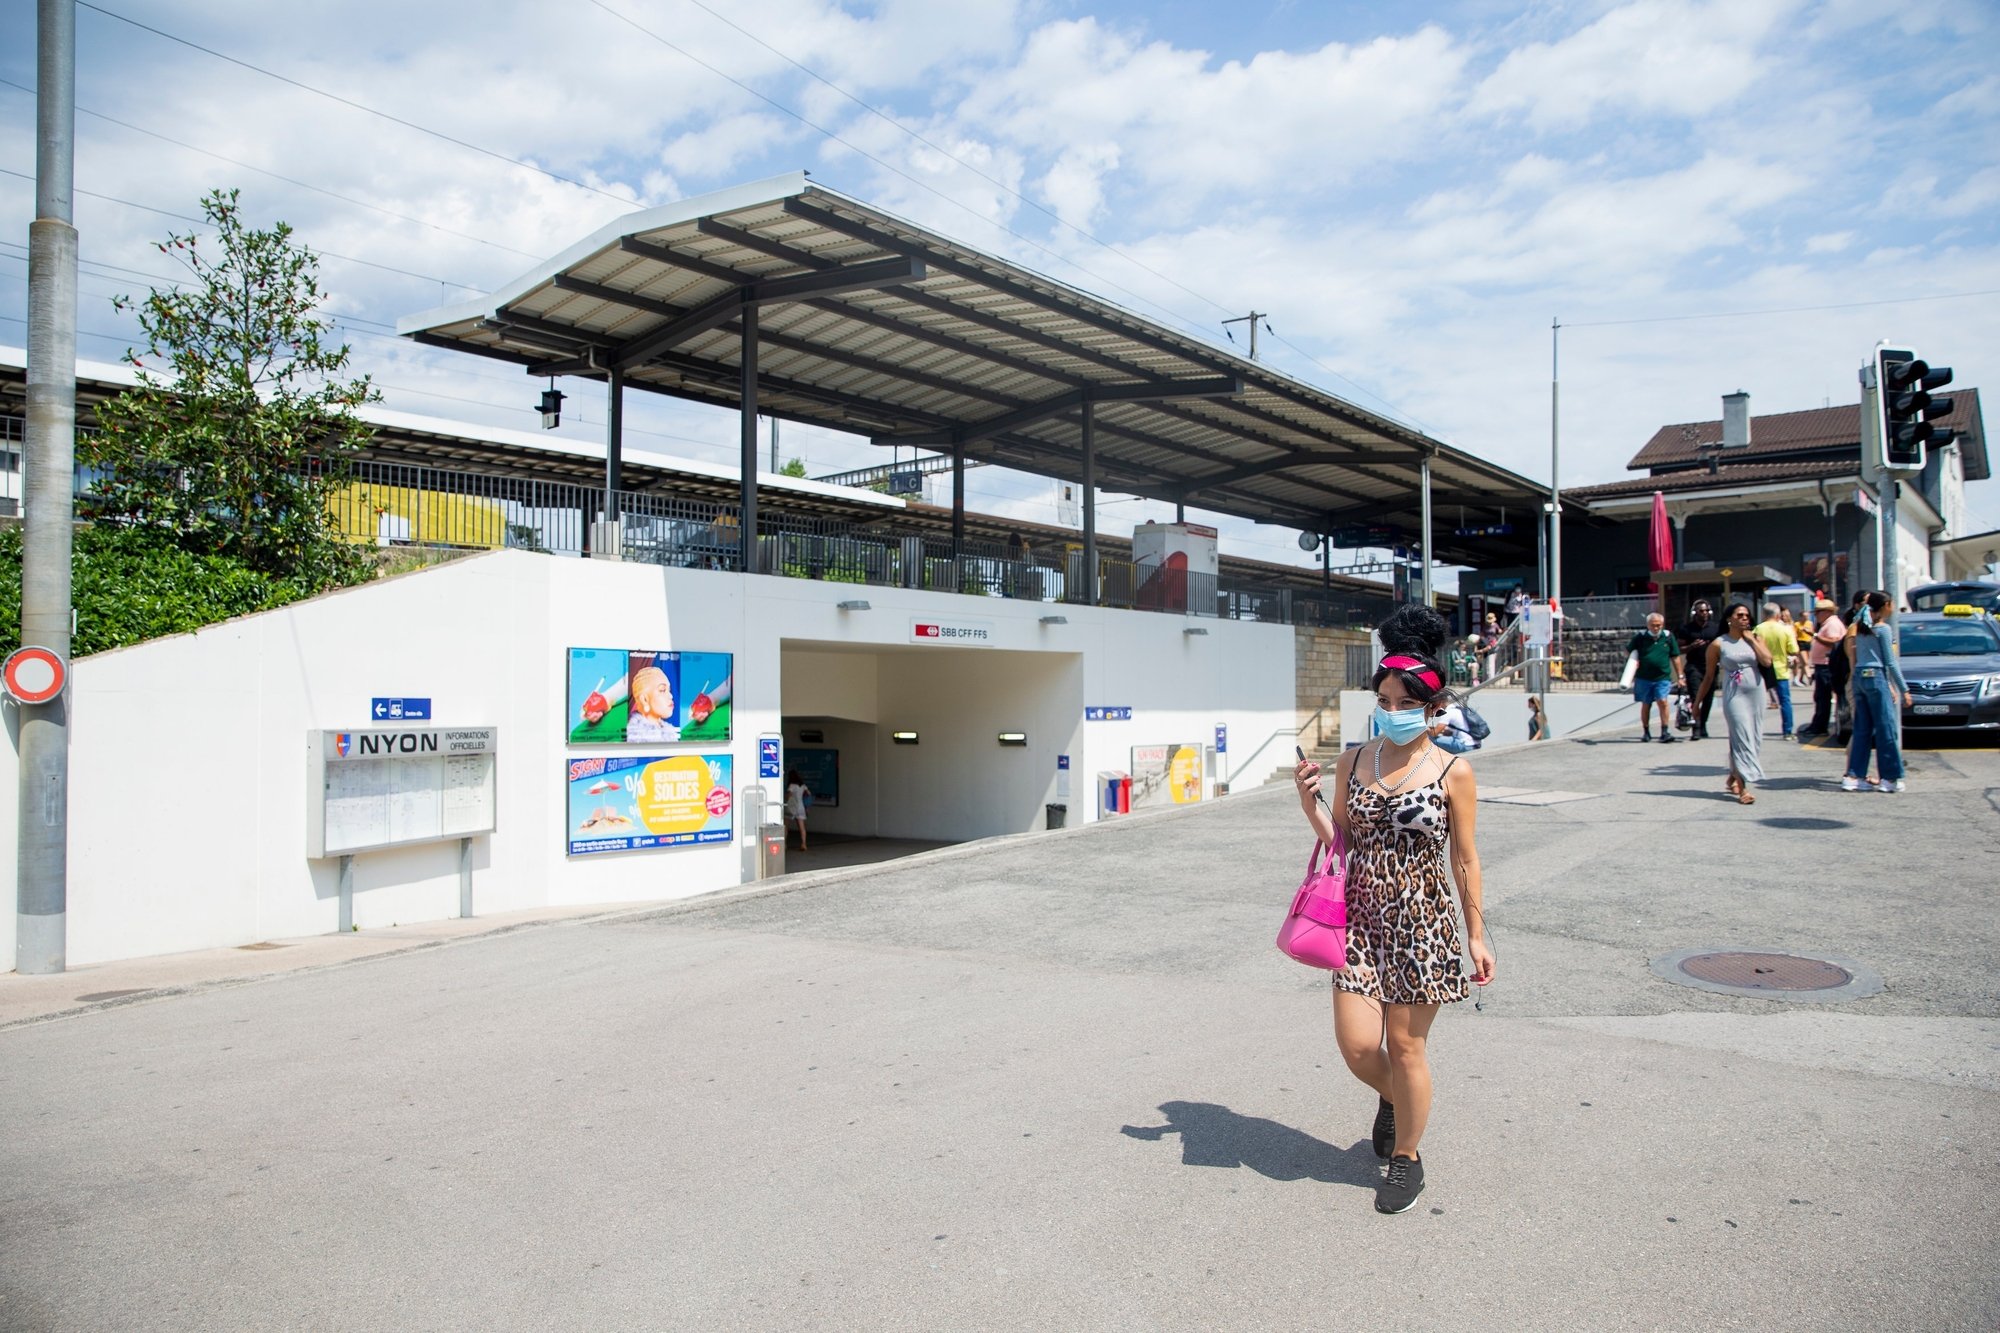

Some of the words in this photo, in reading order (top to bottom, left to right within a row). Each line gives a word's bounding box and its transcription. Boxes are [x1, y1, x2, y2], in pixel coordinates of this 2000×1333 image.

[908, 477, 918, 489] C
[941, 627, 957, 637] SBB
[957, 628, 972, 638] CFF
[973, 629, 988, 639] FFS
[445, 731, 490, 741] INFORMATIONS
[360, 733, 438, 755] NYON
[450, 741, 485, 751] OFFICIELLES
[570, 757, 607, 781] SIGNY
[654, 782, 700, 802] SOLDES
